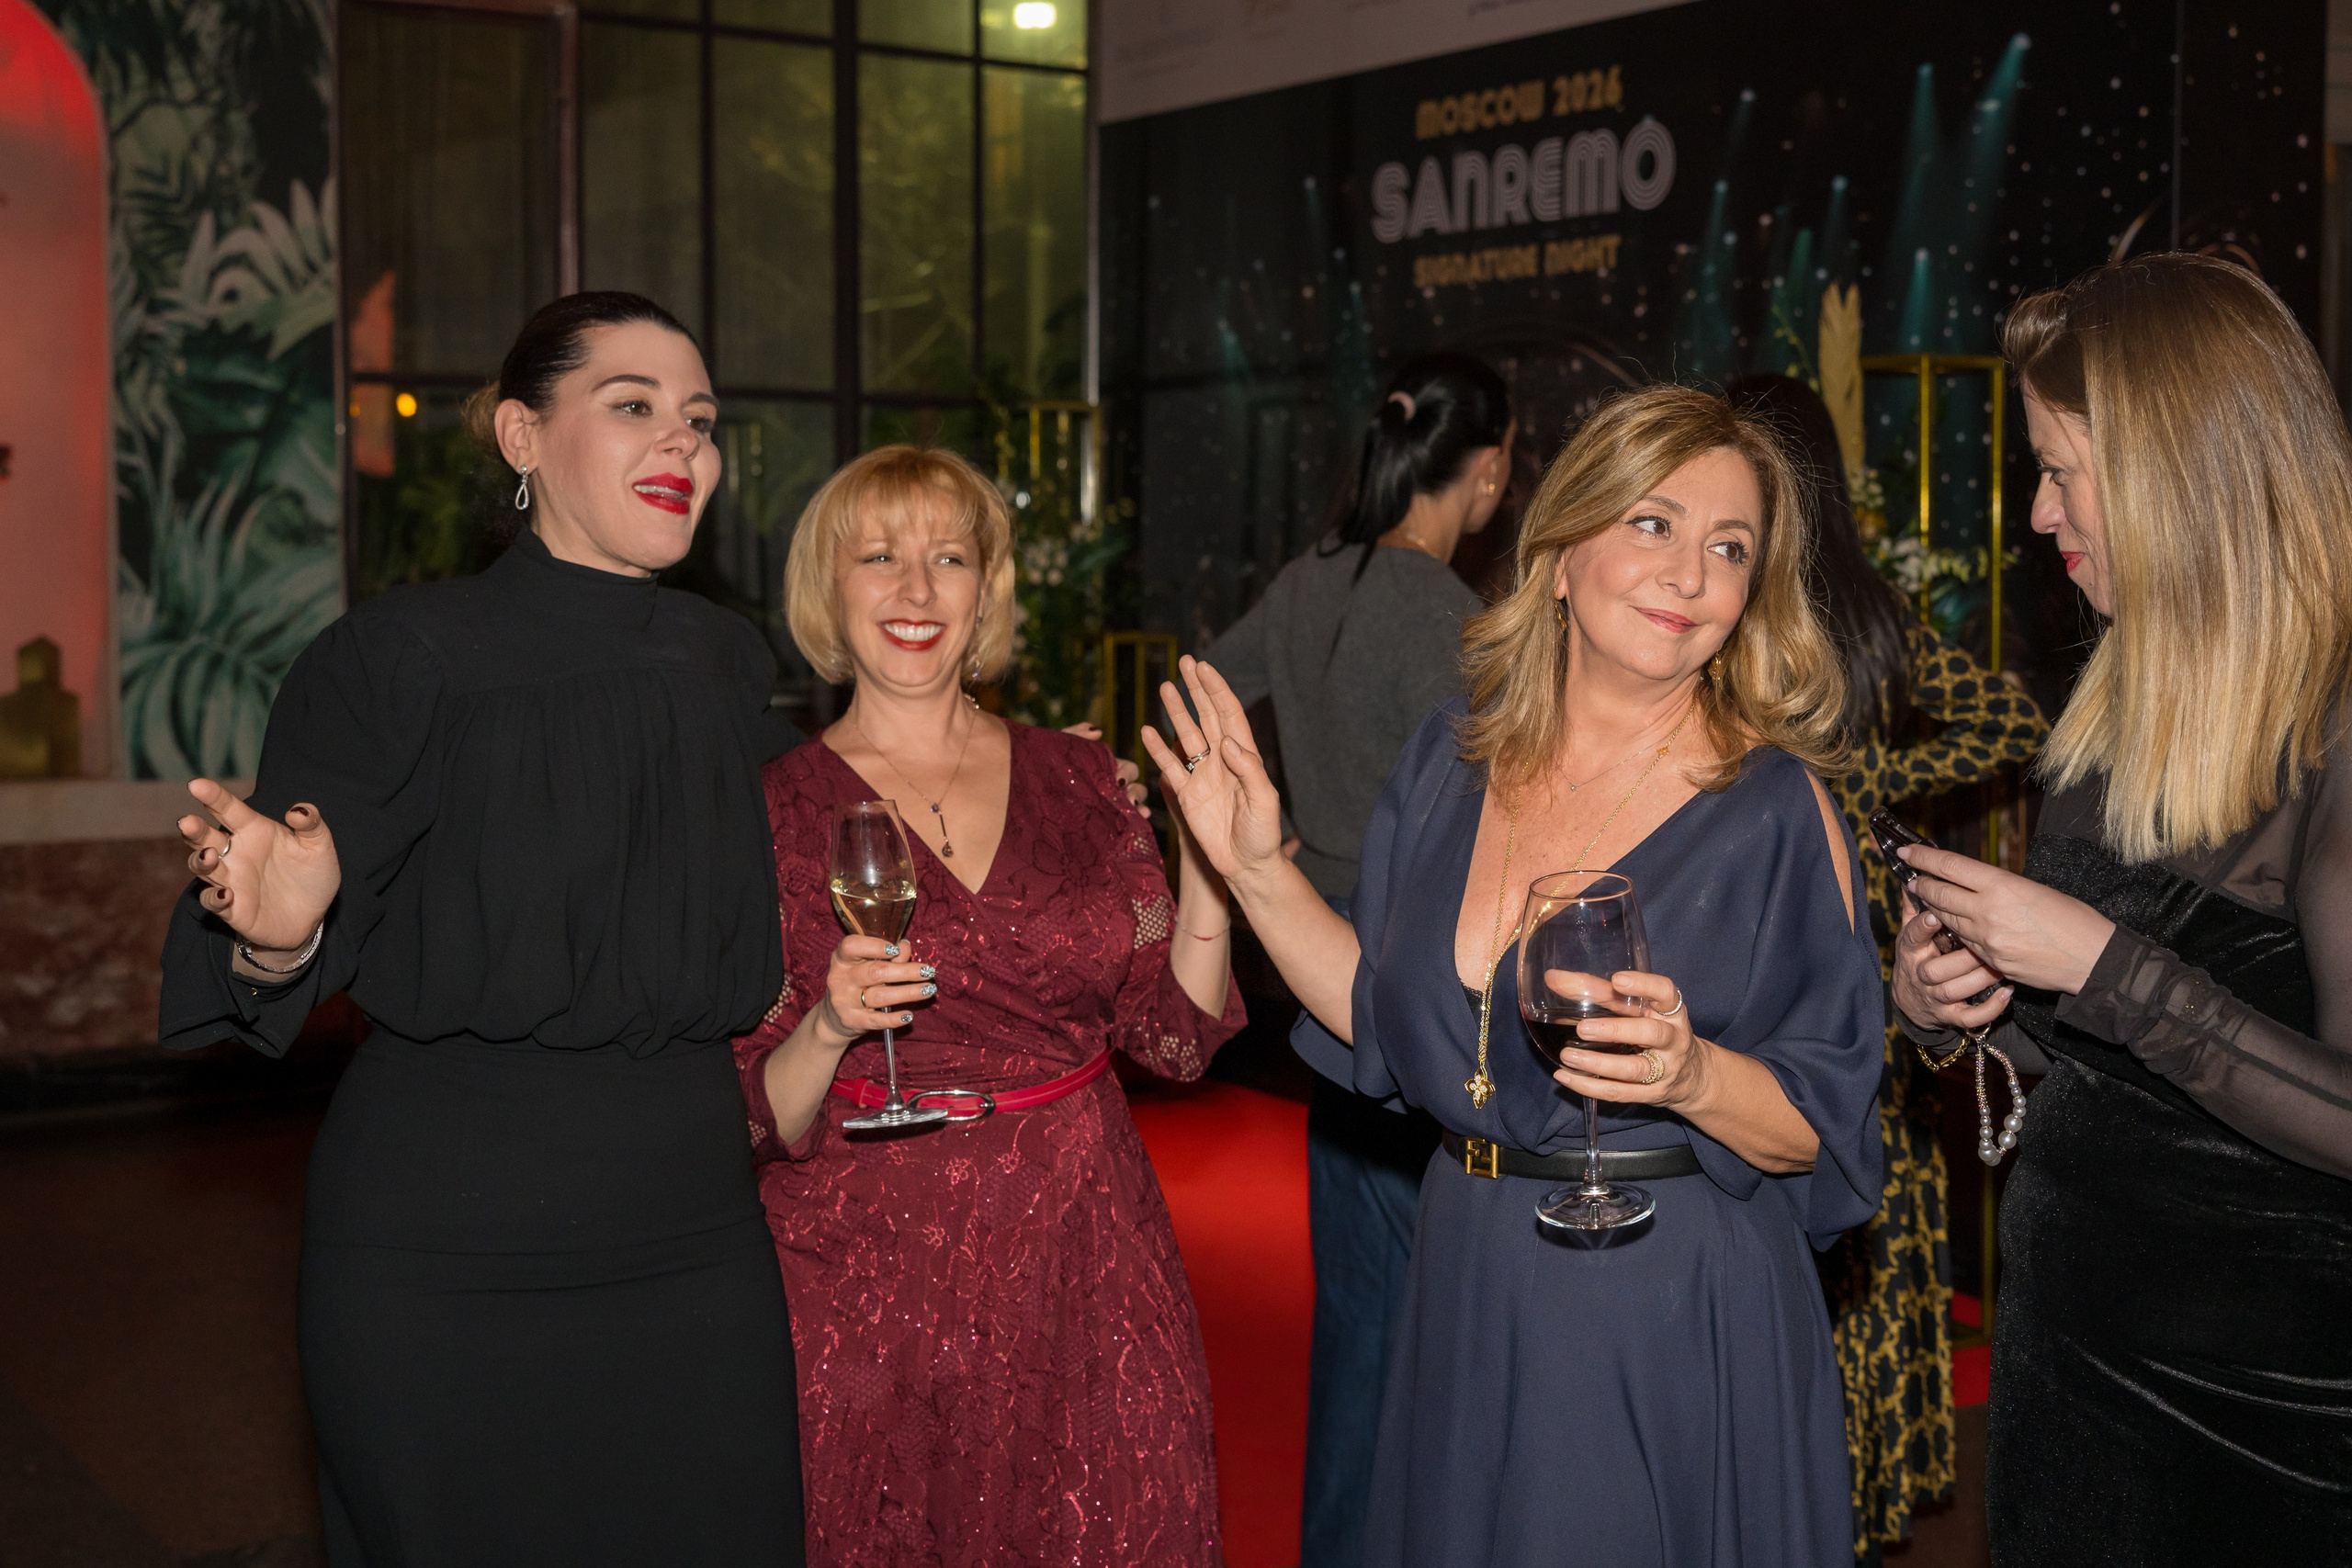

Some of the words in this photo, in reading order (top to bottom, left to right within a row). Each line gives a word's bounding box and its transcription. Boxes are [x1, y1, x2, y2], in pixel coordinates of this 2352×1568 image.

[1416, 81, 1543, 140] MOSCOW
[1554, 65, 1623, 117] 2026
[1372, 119, 1675, 243] SANREMO
